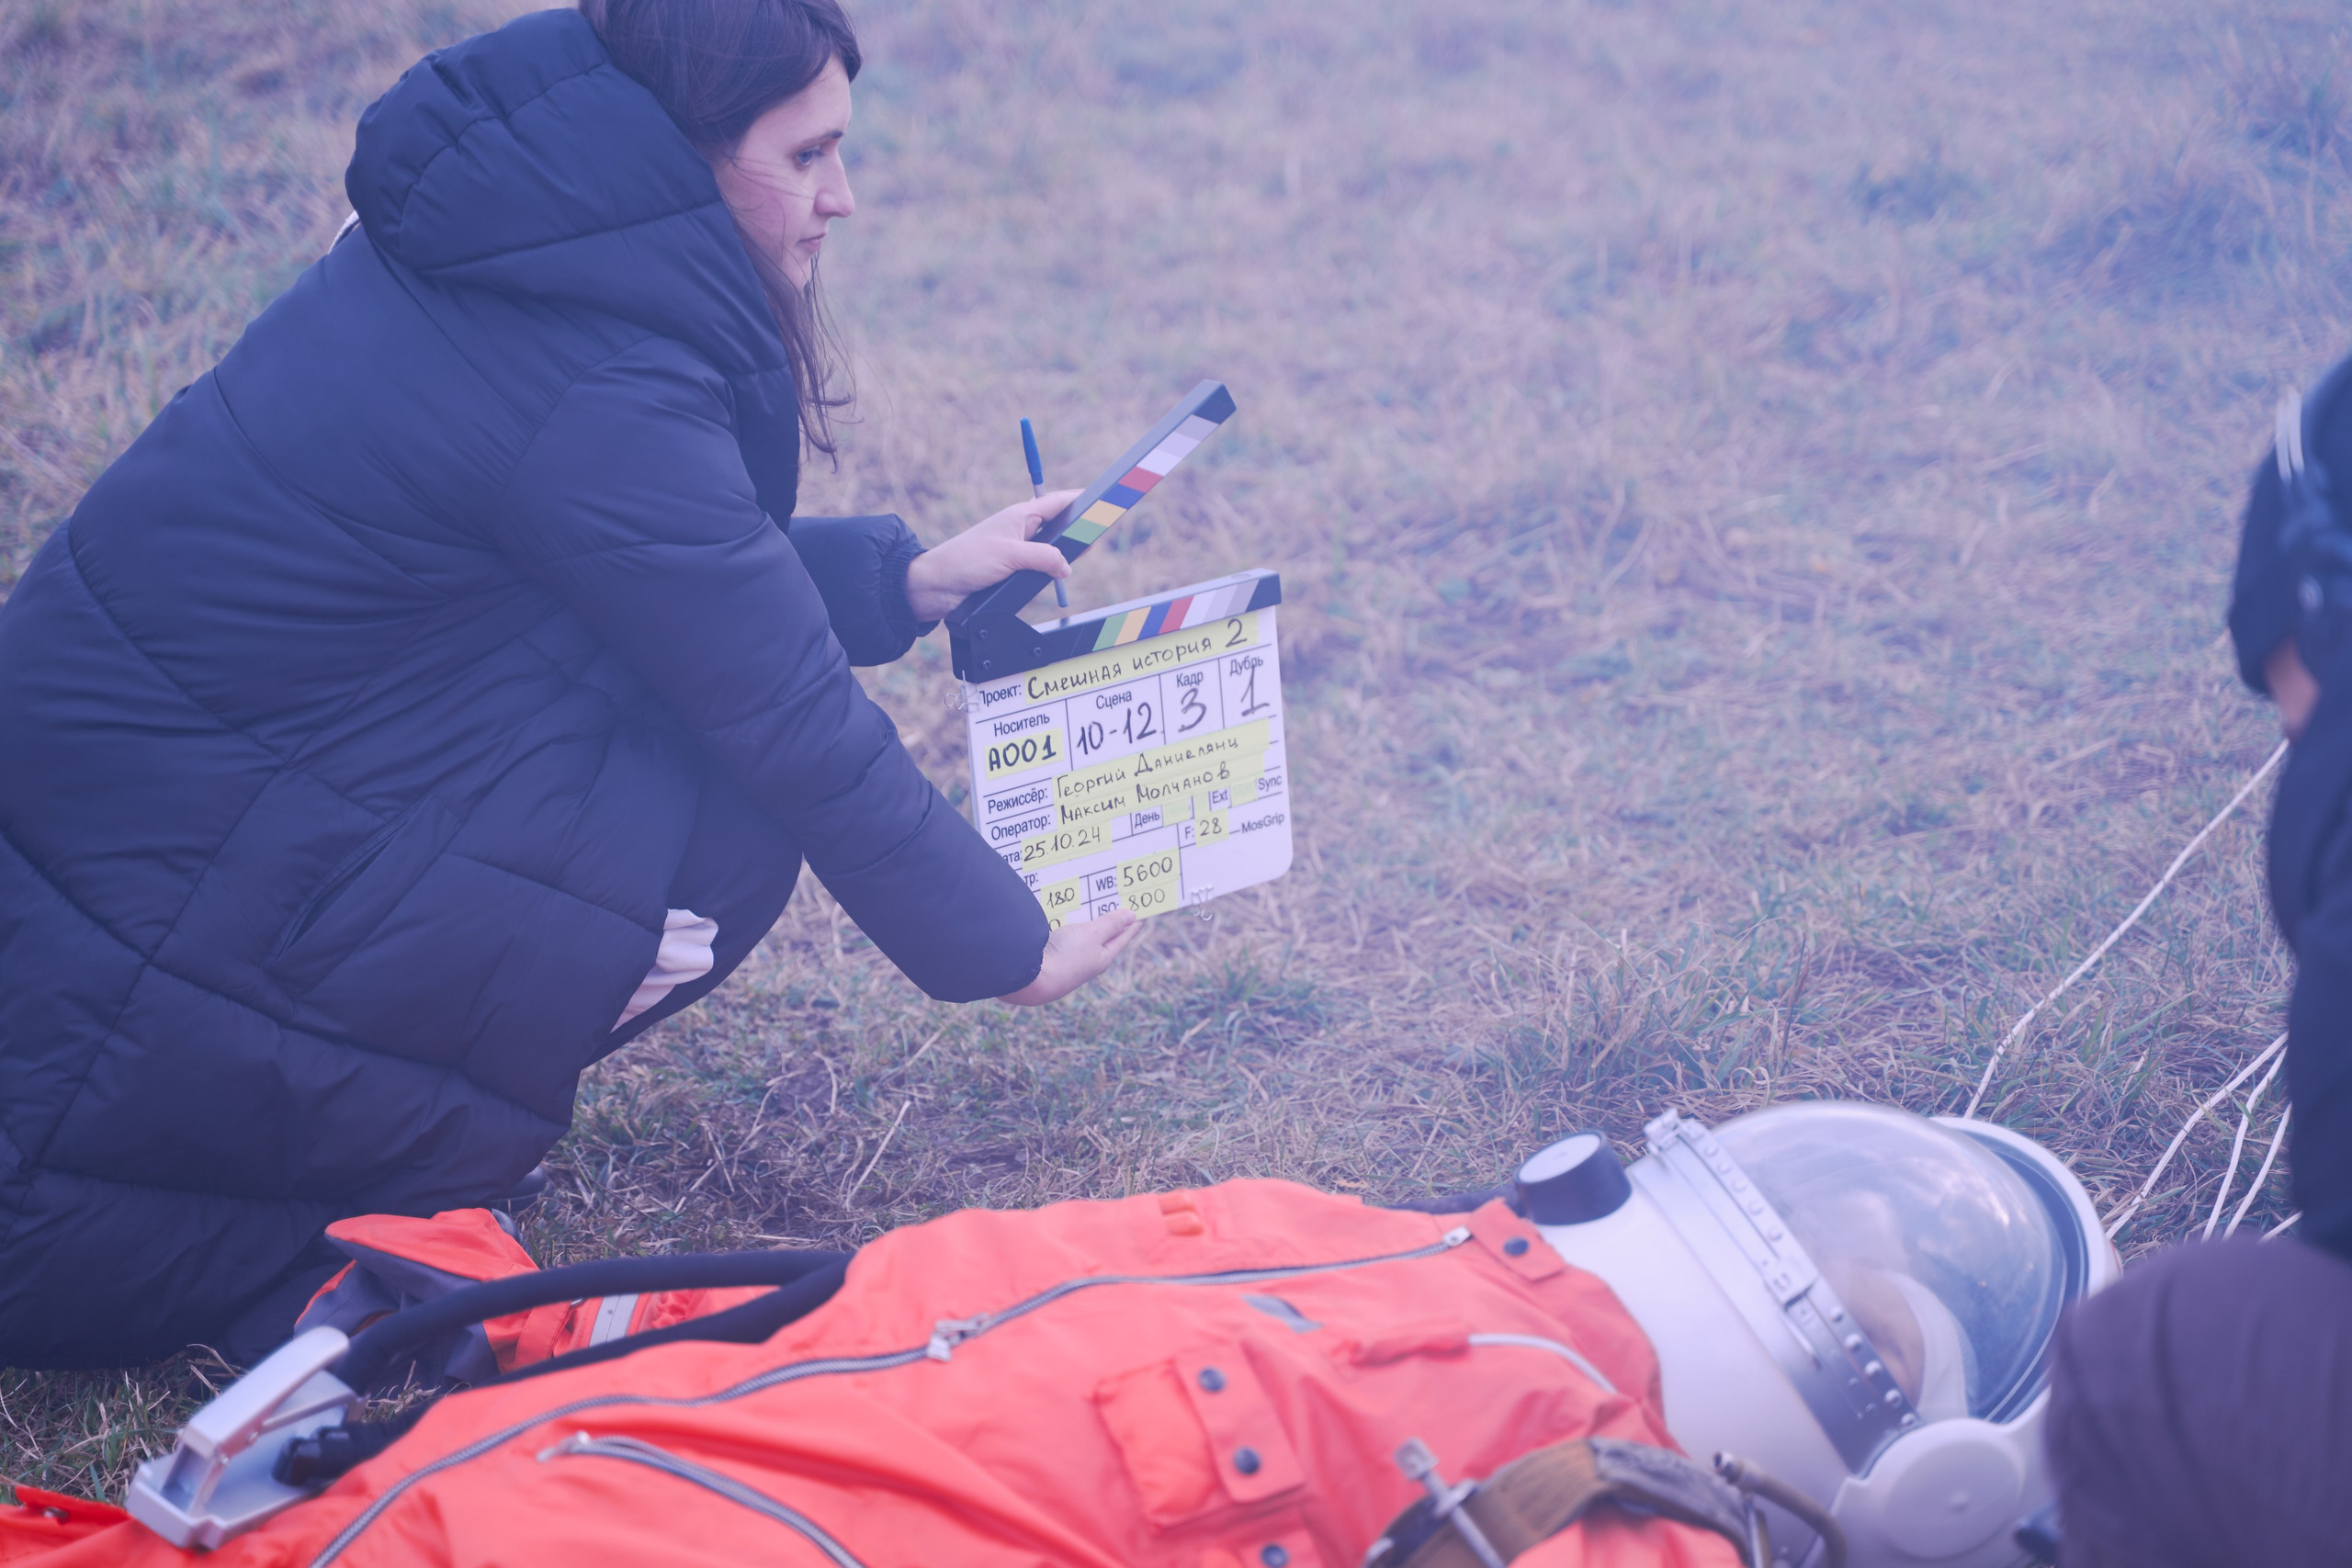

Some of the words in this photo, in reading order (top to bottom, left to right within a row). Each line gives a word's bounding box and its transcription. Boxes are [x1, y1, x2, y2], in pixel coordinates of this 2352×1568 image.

[1028, 662, 1122, 700] Смешная
[1132, 638, 1211, 671] история
[1225, 618, 1248, 648] 2
[1176, 671, 1204, 688] Кадр
[1241, 665, 1270, 716] 1
[1095, 691, 1132, 710] Сцена
[1179, 688, 1206, 732] 3
[993, 713, 1050, 737] Носитель
[1077, 702, 1157, 755] 10-12
[1057, 769, 1125, 797] Георгий
[1135, 738, 1238, 776] Даниелянц
[1258, 776, 1283, 793] Sync
[987, 787, 1048, 815] Режиссёр:
[1212, 789, 1228, 804] Ext
[991, 815, 1051, 840] Оператор:
[1135, 812, 1160, 829] День
[1241, 813, 1285, 833] MosGrip
[1123, 856, 1172, 887] 5600
[1096, 876, 1116, 892] WB:
[1046, 887, 1075, 908] 180
[1128, 888, 1165, 911] 800
